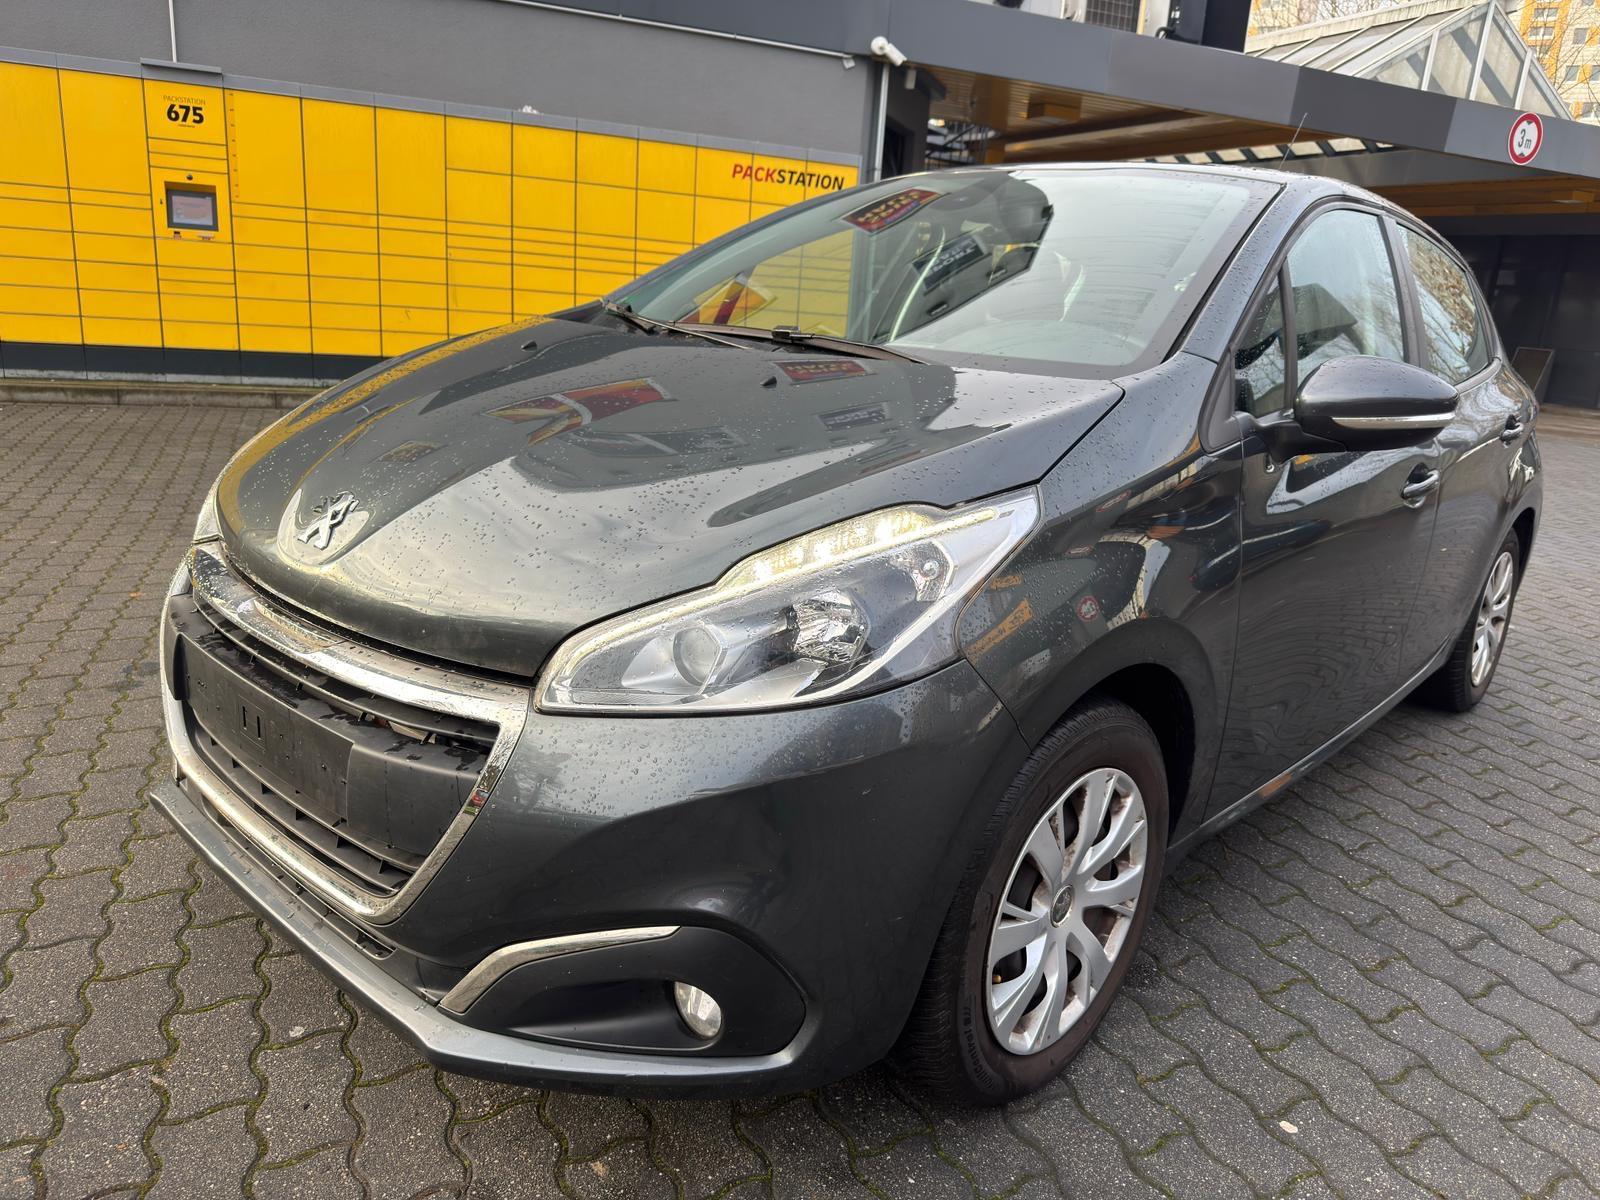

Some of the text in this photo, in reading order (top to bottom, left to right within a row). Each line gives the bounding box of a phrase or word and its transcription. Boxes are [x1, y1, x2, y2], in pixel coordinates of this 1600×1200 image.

[163, 95, 206, 105] PACKSTATION
[167, 103, 204, 124] 675
[732, 164, 845, 190] PACKSTATION
